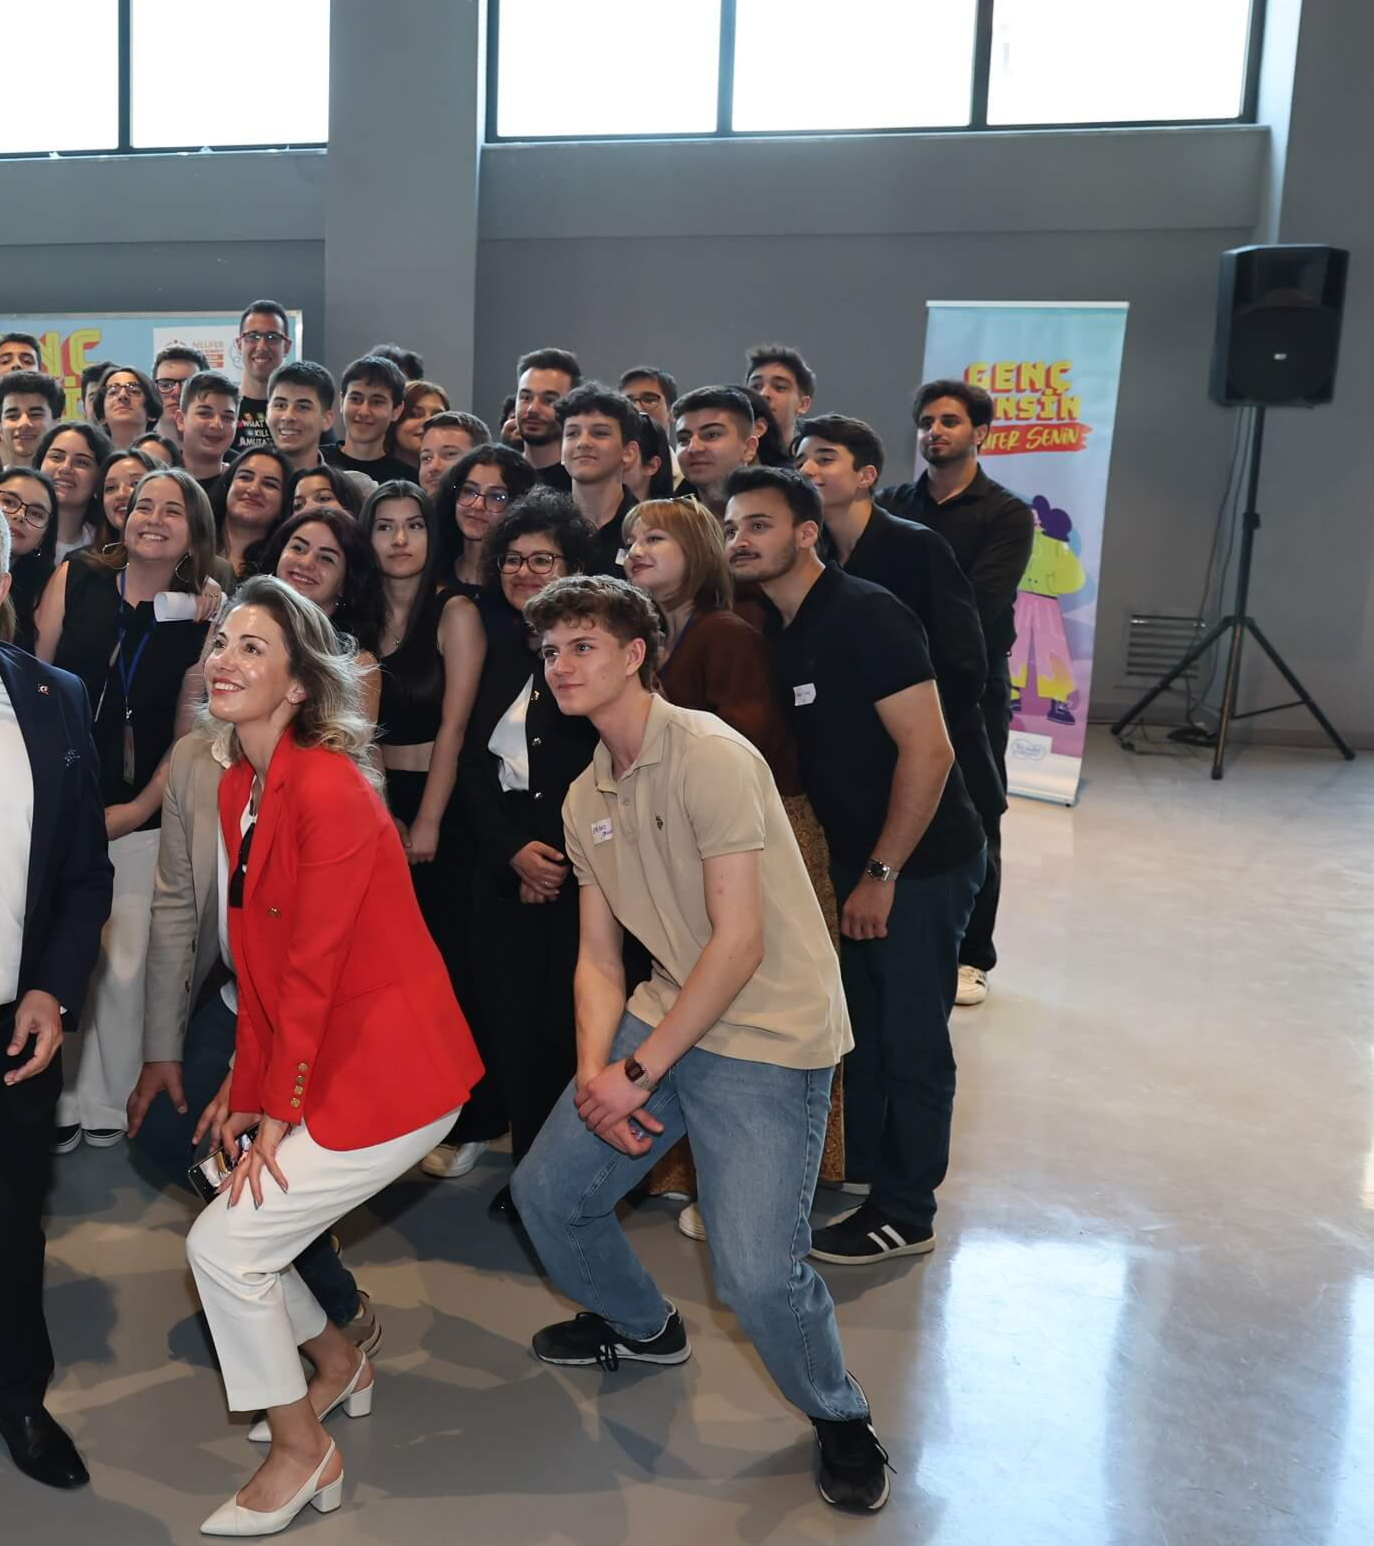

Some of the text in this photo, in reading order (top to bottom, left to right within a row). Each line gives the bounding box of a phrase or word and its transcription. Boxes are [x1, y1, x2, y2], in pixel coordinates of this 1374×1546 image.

[964, 361, 1073, 395] GENÇ
[994, 387, 1082, 421] NSİN
[242, 420, 264, 428] WHAT
